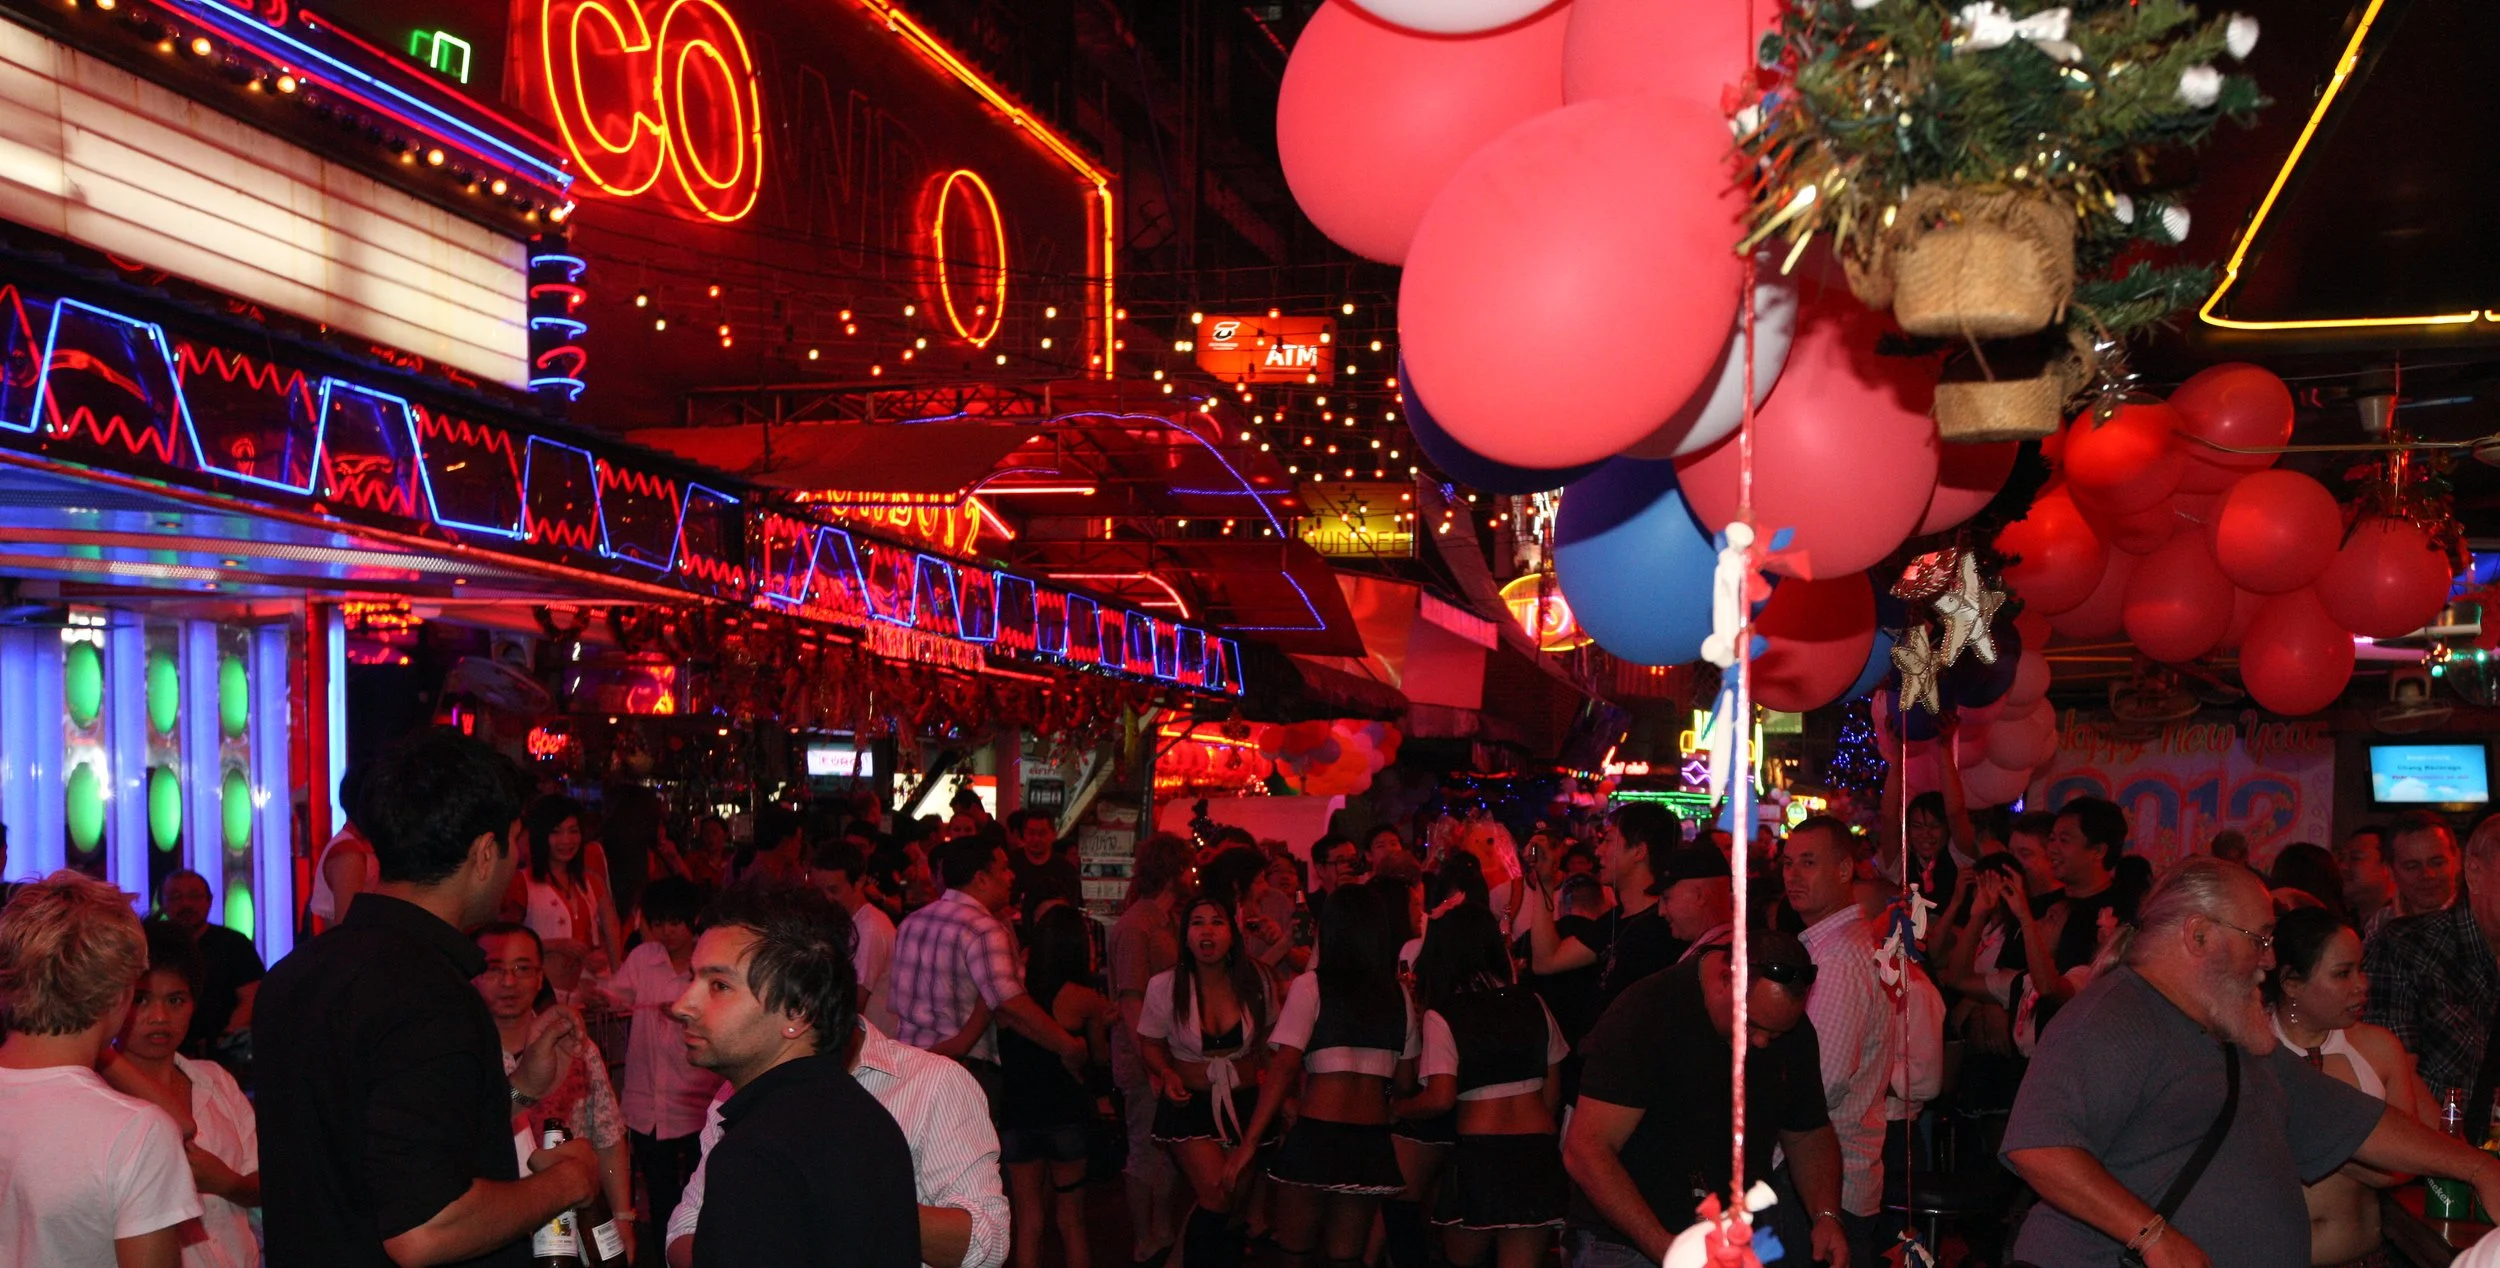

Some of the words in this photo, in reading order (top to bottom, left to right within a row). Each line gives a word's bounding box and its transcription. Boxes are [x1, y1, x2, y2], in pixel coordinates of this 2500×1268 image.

[1265, 344, 1318, 367] ATM
[528, 727, 567, 762] Open
[2159, 720, 2237, 754] New
[2239, 709, 2328, 765] Year
[2427, 1178, 2452, 1205] neken
